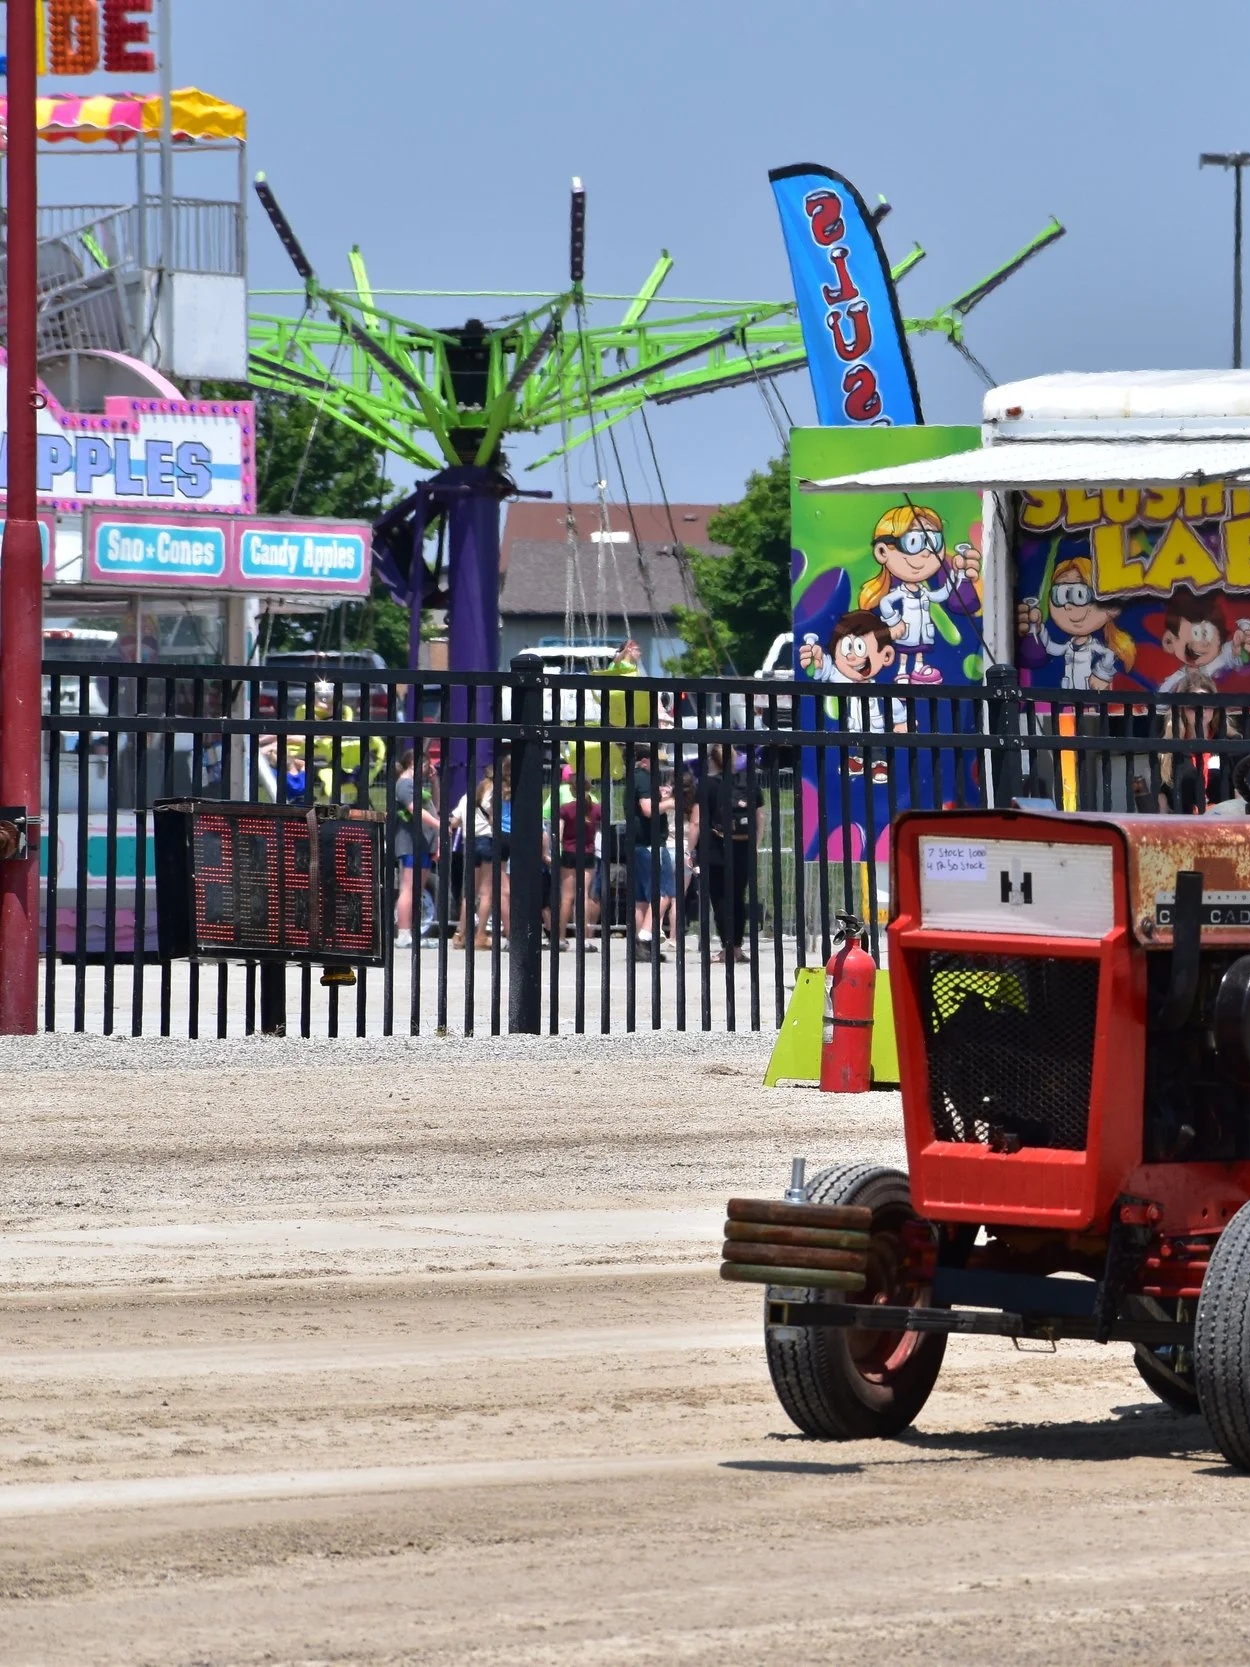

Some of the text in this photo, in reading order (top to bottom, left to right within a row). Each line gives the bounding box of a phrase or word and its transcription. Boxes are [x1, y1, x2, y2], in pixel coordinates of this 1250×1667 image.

[0, 432, 212, 498] PPLES
[108, 529, 215, 566] Sno Cones
[250, 536, 356, 575] Candy Apples
[939, 848, 964, 858] Stock
